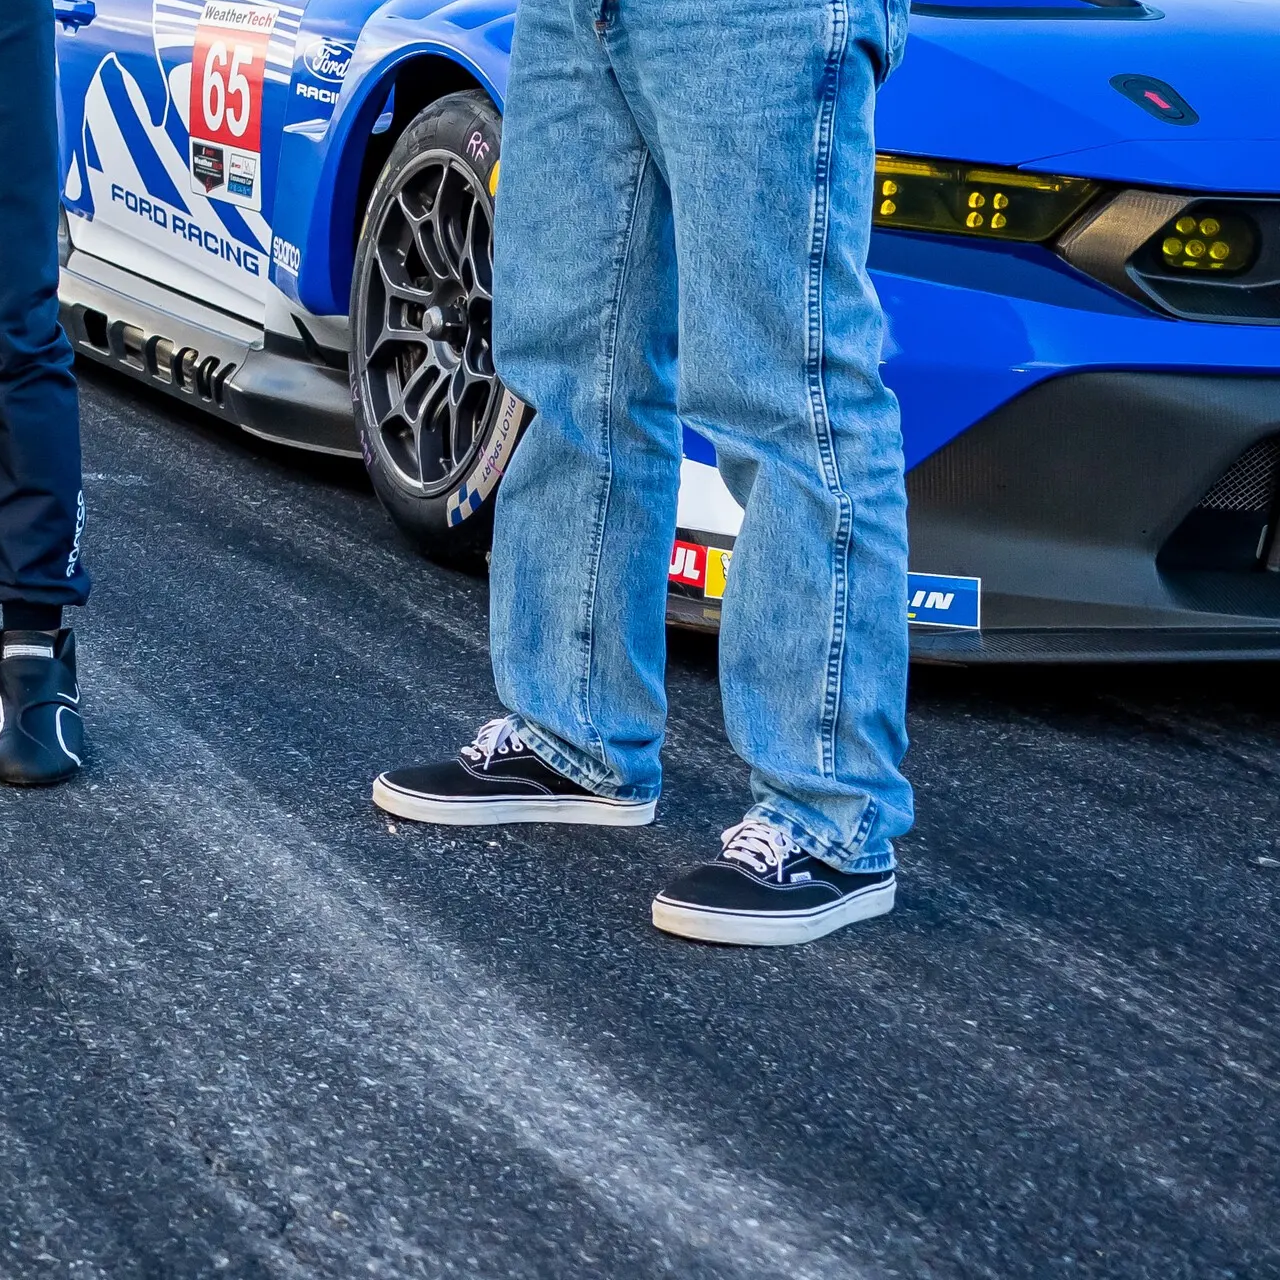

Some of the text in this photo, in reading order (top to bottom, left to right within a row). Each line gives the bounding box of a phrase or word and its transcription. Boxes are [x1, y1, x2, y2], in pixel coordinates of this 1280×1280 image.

[204, 5, 274, 28] WeatherTech
[312, 44, 351, 78] Ford
[202, 40, 254, 138] 65
[466, 131, 490, 162] RF
[111, 184, 260, 277] FORD RACING
[273, 235, 301, 277] sparco
[501, 396, 516, 441] PILOT
[482, 440, 503, 482] SPORT
[66, 490, 85, 577] sparco
[908, 590, 955, 610] IN
